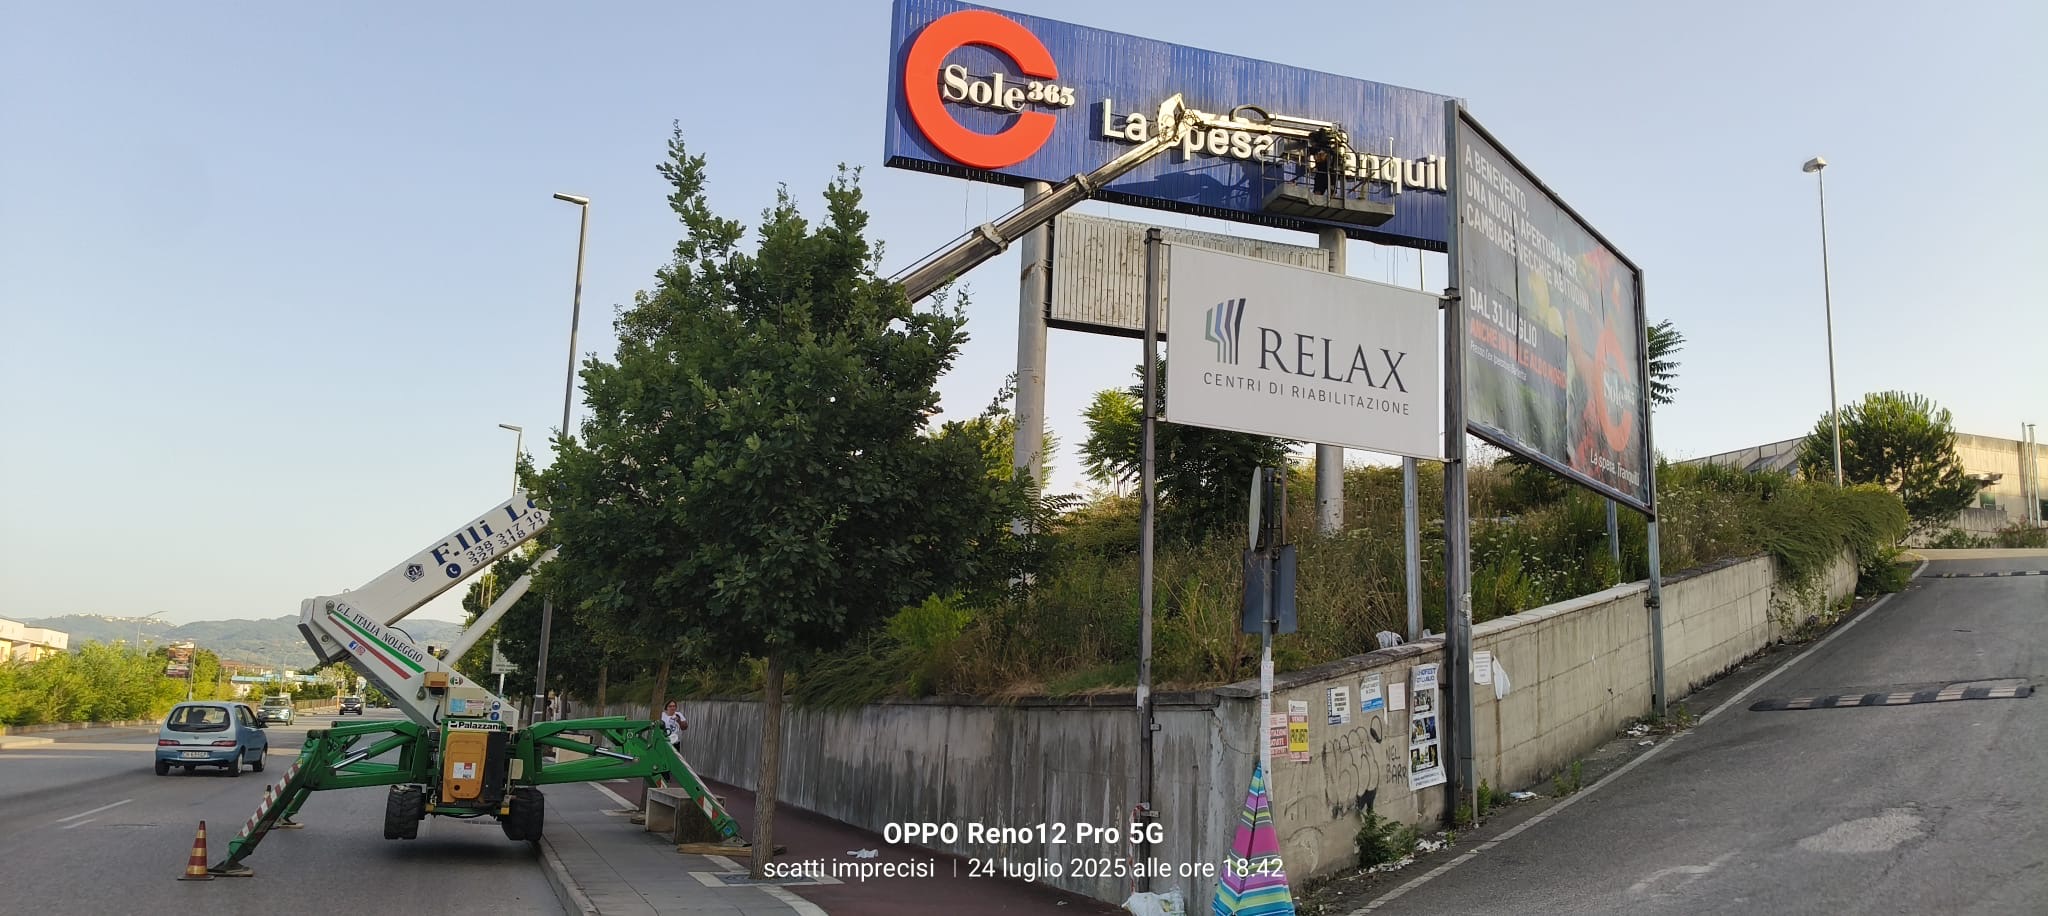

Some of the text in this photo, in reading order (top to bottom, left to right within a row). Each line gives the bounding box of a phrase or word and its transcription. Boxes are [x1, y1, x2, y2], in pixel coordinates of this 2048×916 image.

[1102, 98, 1147, 142] La
[1182, 128, 1276, 163] pesa
[1465, 143, 1530, 218] A BENEVENTO,
[1466, 172, 1577, 281] UNA NUOVA APERTURA PER
[1466, 203, 1516, 256] CAMBIARE
[1517, 240, 1552, 285] VECCHIE
[1469, 286, 1537, 349] DAL 31 LUGLIO
[1257, 326, 1409, 393] RELAX
[1203, 372, 1410, 416] CENTRI DI RIABILITAZIONE
[1590, 447, 1597, 465] La
[430, 520, 495, 567] F.lli
[466, 510, 542, 560] 338 317 10
[471, 547, 495, 566] 327
[500, 530, 526, 548] 318
[352, 613, 380, 636] ITALIA
[381, 632, 424, 663] NOLEGGIO
